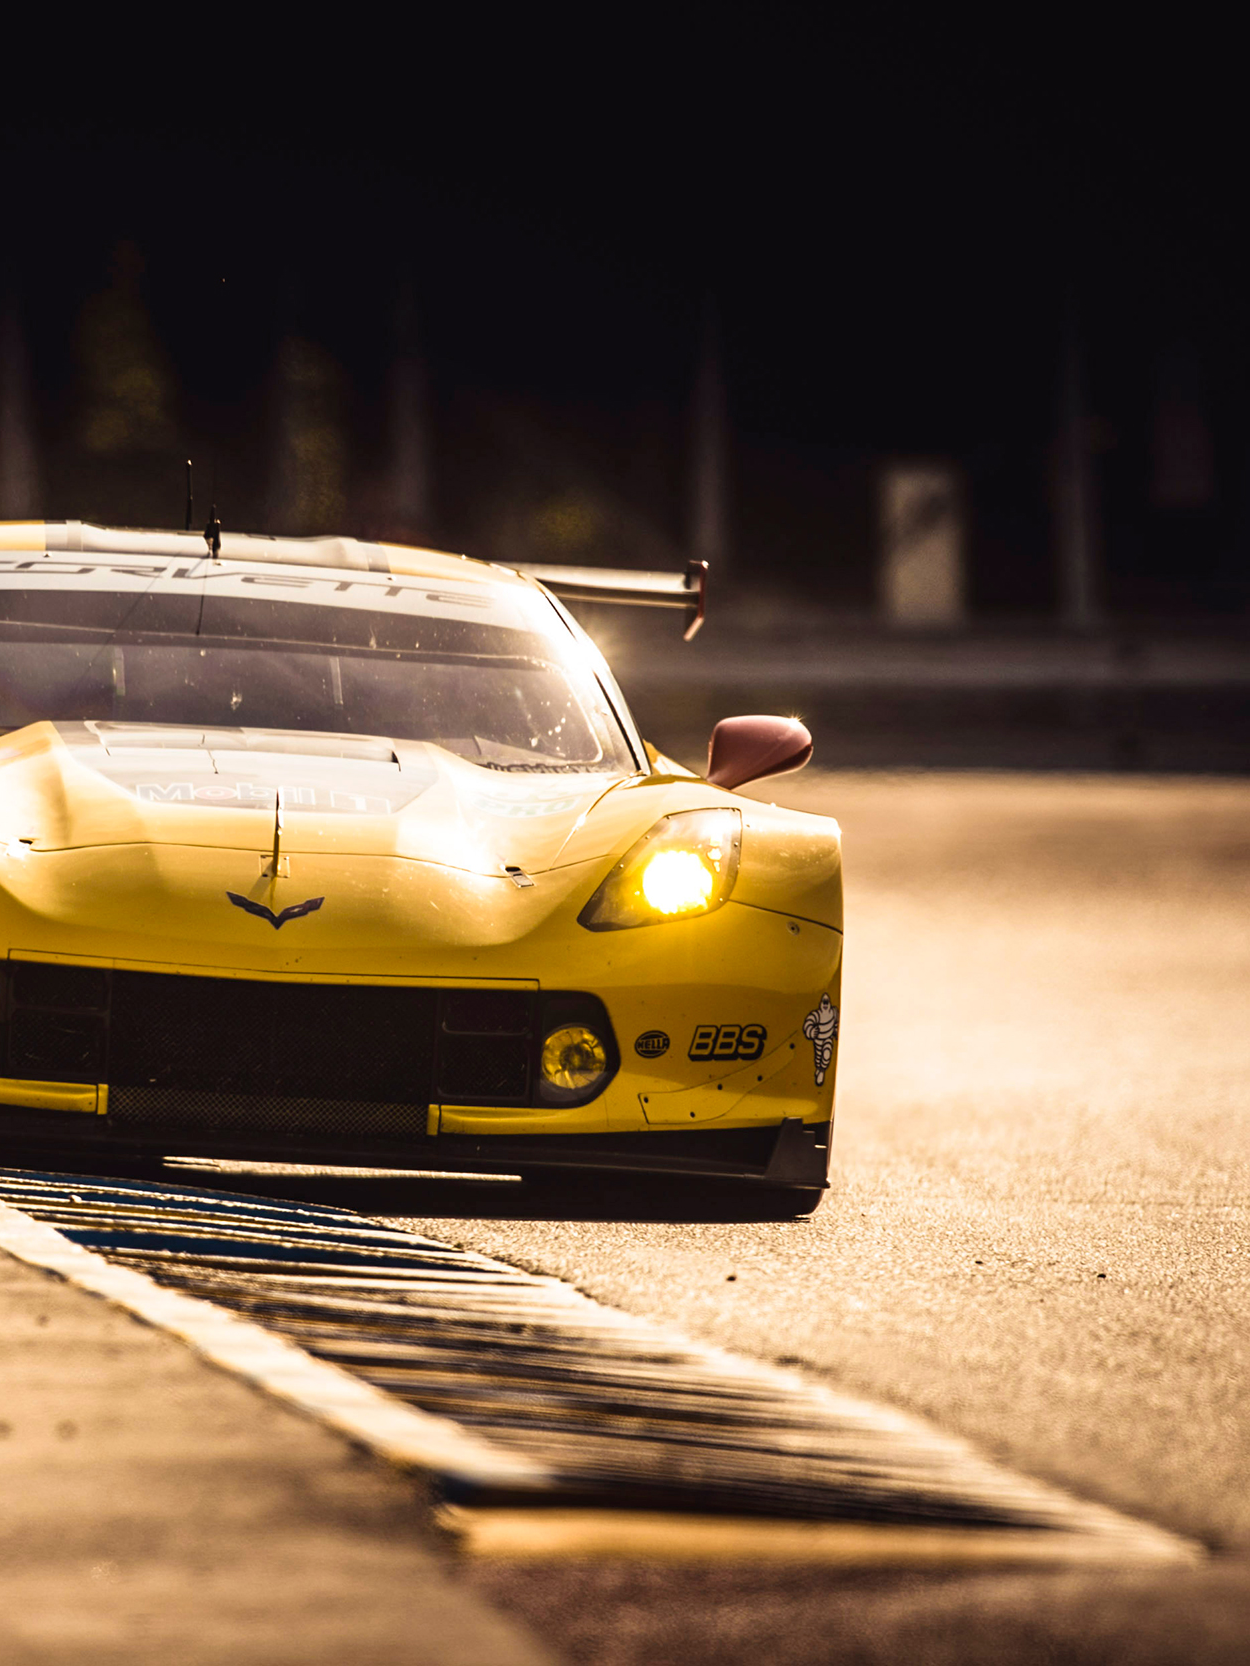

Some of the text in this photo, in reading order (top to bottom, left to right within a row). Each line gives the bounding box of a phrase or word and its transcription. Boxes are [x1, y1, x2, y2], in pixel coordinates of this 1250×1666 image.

[136, 783, 316, 806] Mobil
[636, 1036, 671, 1052] HELLA
[688, 1024, 767, 1061] BBS
